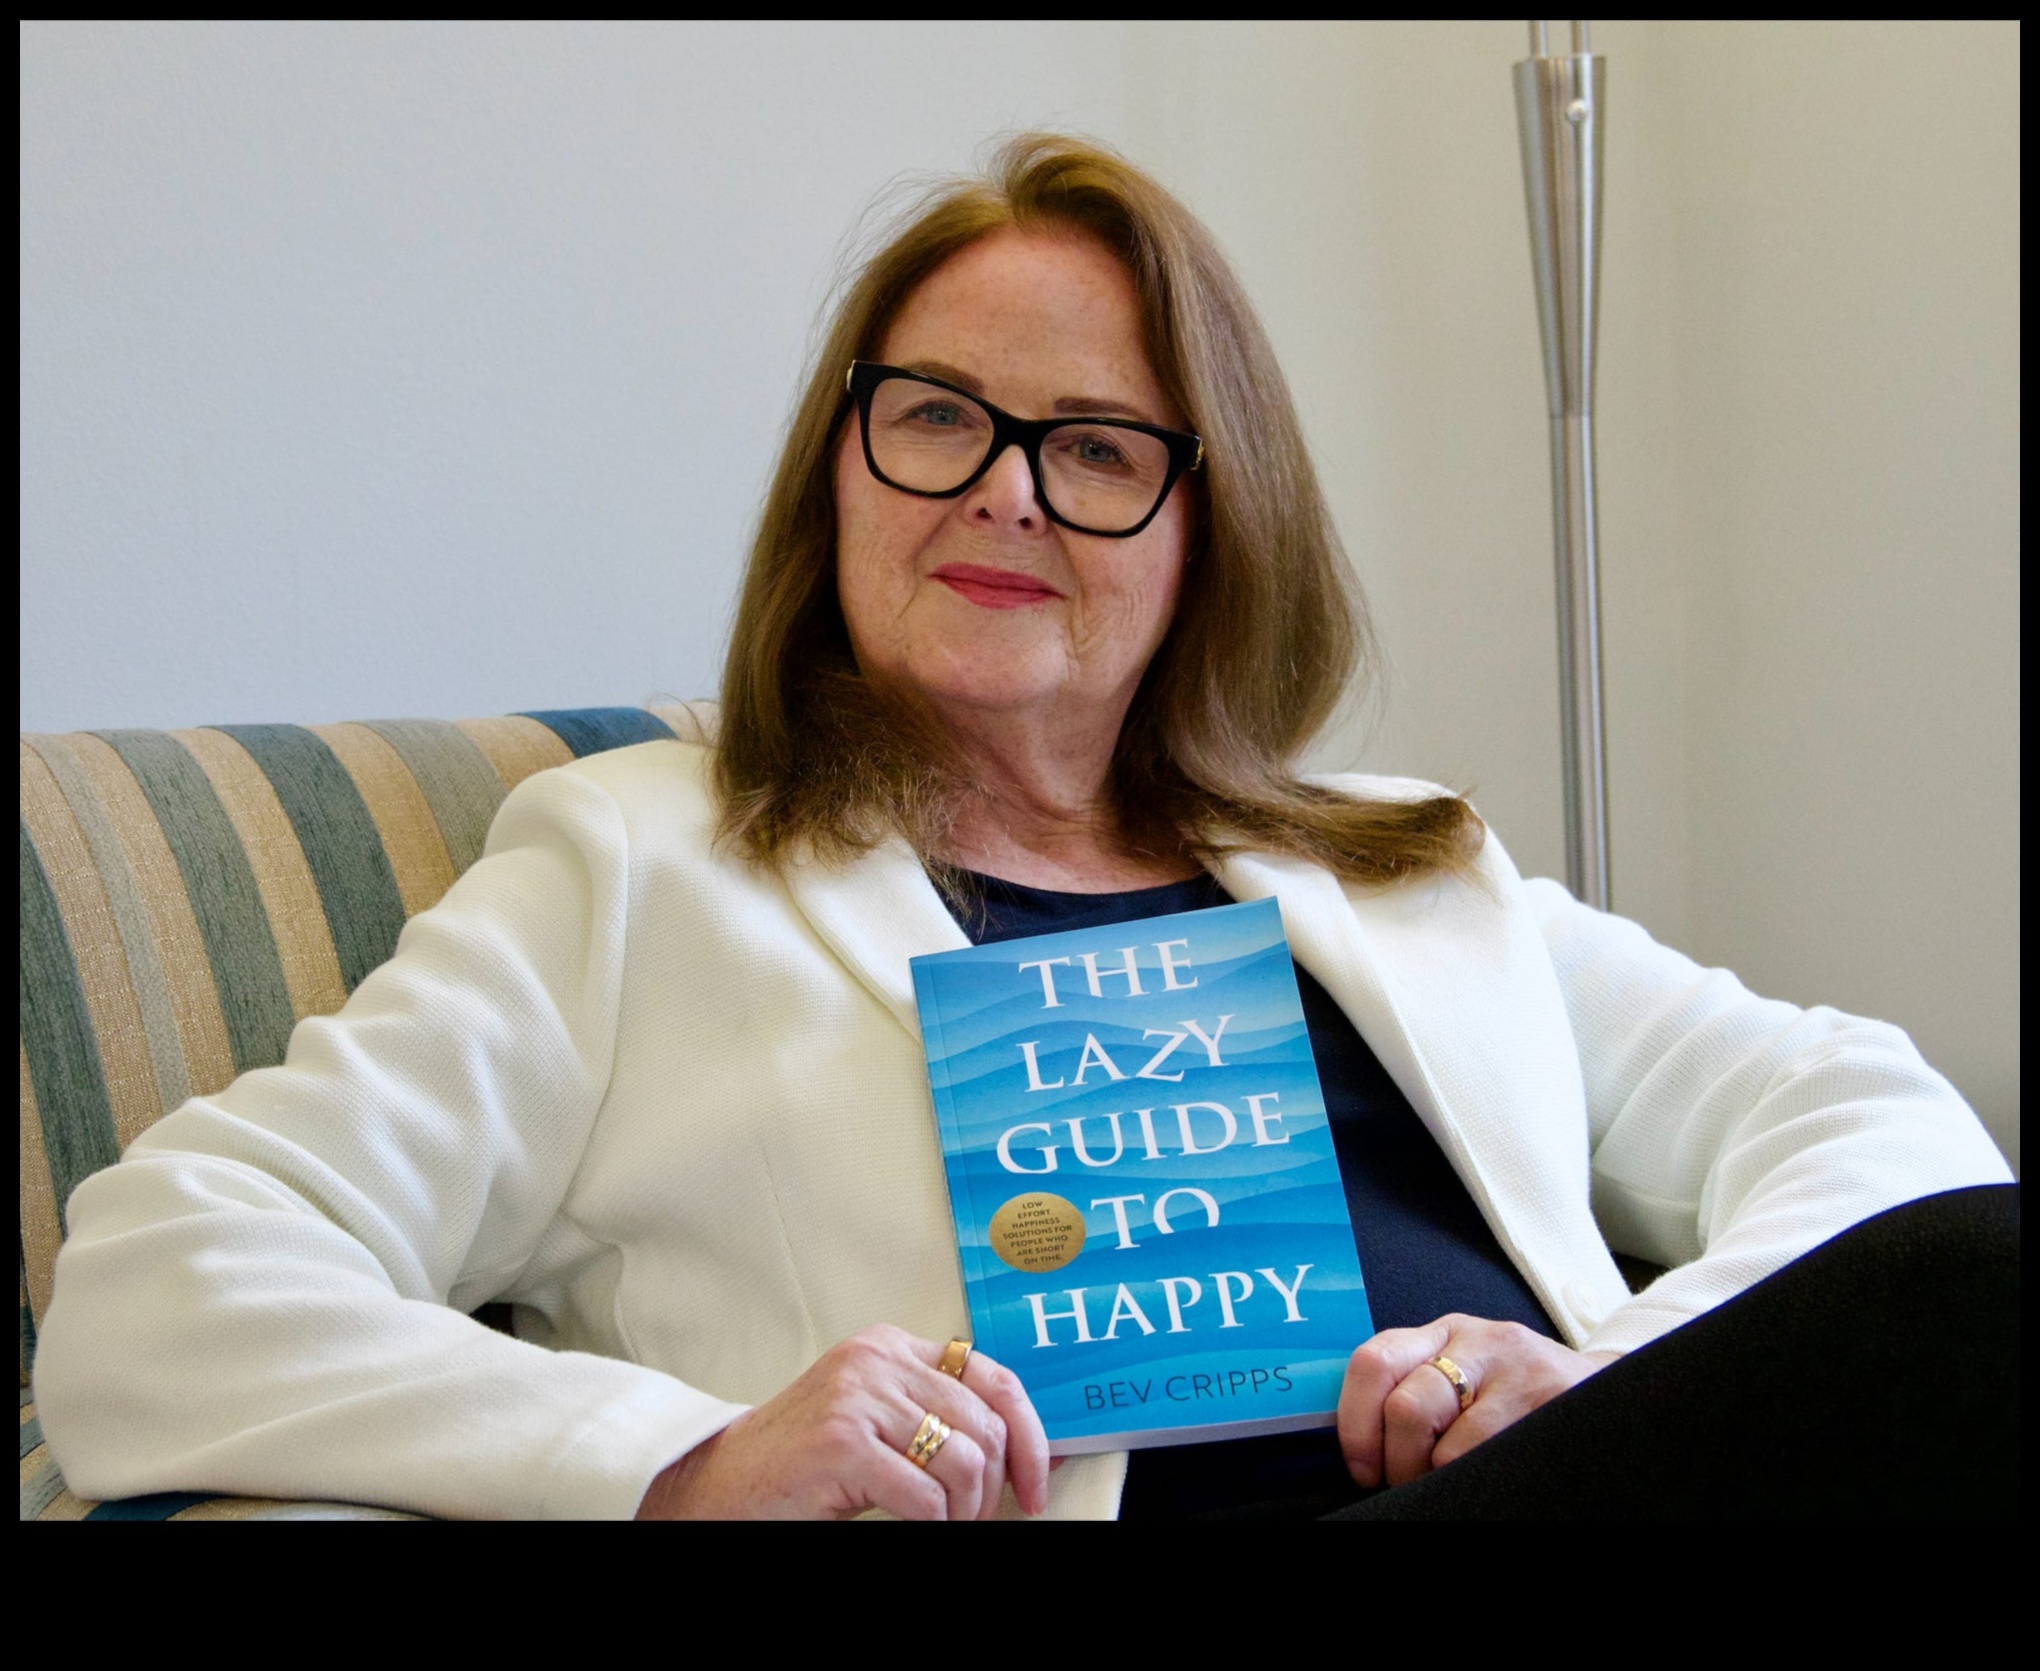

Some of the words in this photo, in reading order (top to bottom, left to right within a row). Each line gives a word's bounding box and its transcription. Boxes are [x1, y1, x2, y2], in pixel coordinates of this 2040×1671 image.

[1019, 938, 1198, 1009] THE
[1016, 1014, 1235, 1092] LAZY
[996, 1092, 1290, 1175] GUIDE
[1022, 1201, 1043, 1210] LOW
[1018, 1209, 1050, 1219] EFFORT
[1091, 1187, 1220, 1250] TO
[1012, 1217, 1060, 1229] HAPPINESS
[1003, 1227, 1053, 1240] SOLUTIONS
[1054, 1225, 1072, 1233] FOR
[1010, 1238, 1043, 1248] PEOPLE
[1045, 1235, 1068, 1243] WHO
[1035, 1244, 1065, 1254] SHORT
[1024, 1257, 1038, 1265] ON
[1022, 1264, 1315, 1348] HAPPY
[1084, 1379, 1153, 1410] BEV
[1165, 1366, 1293, 1401] CRIPPS
